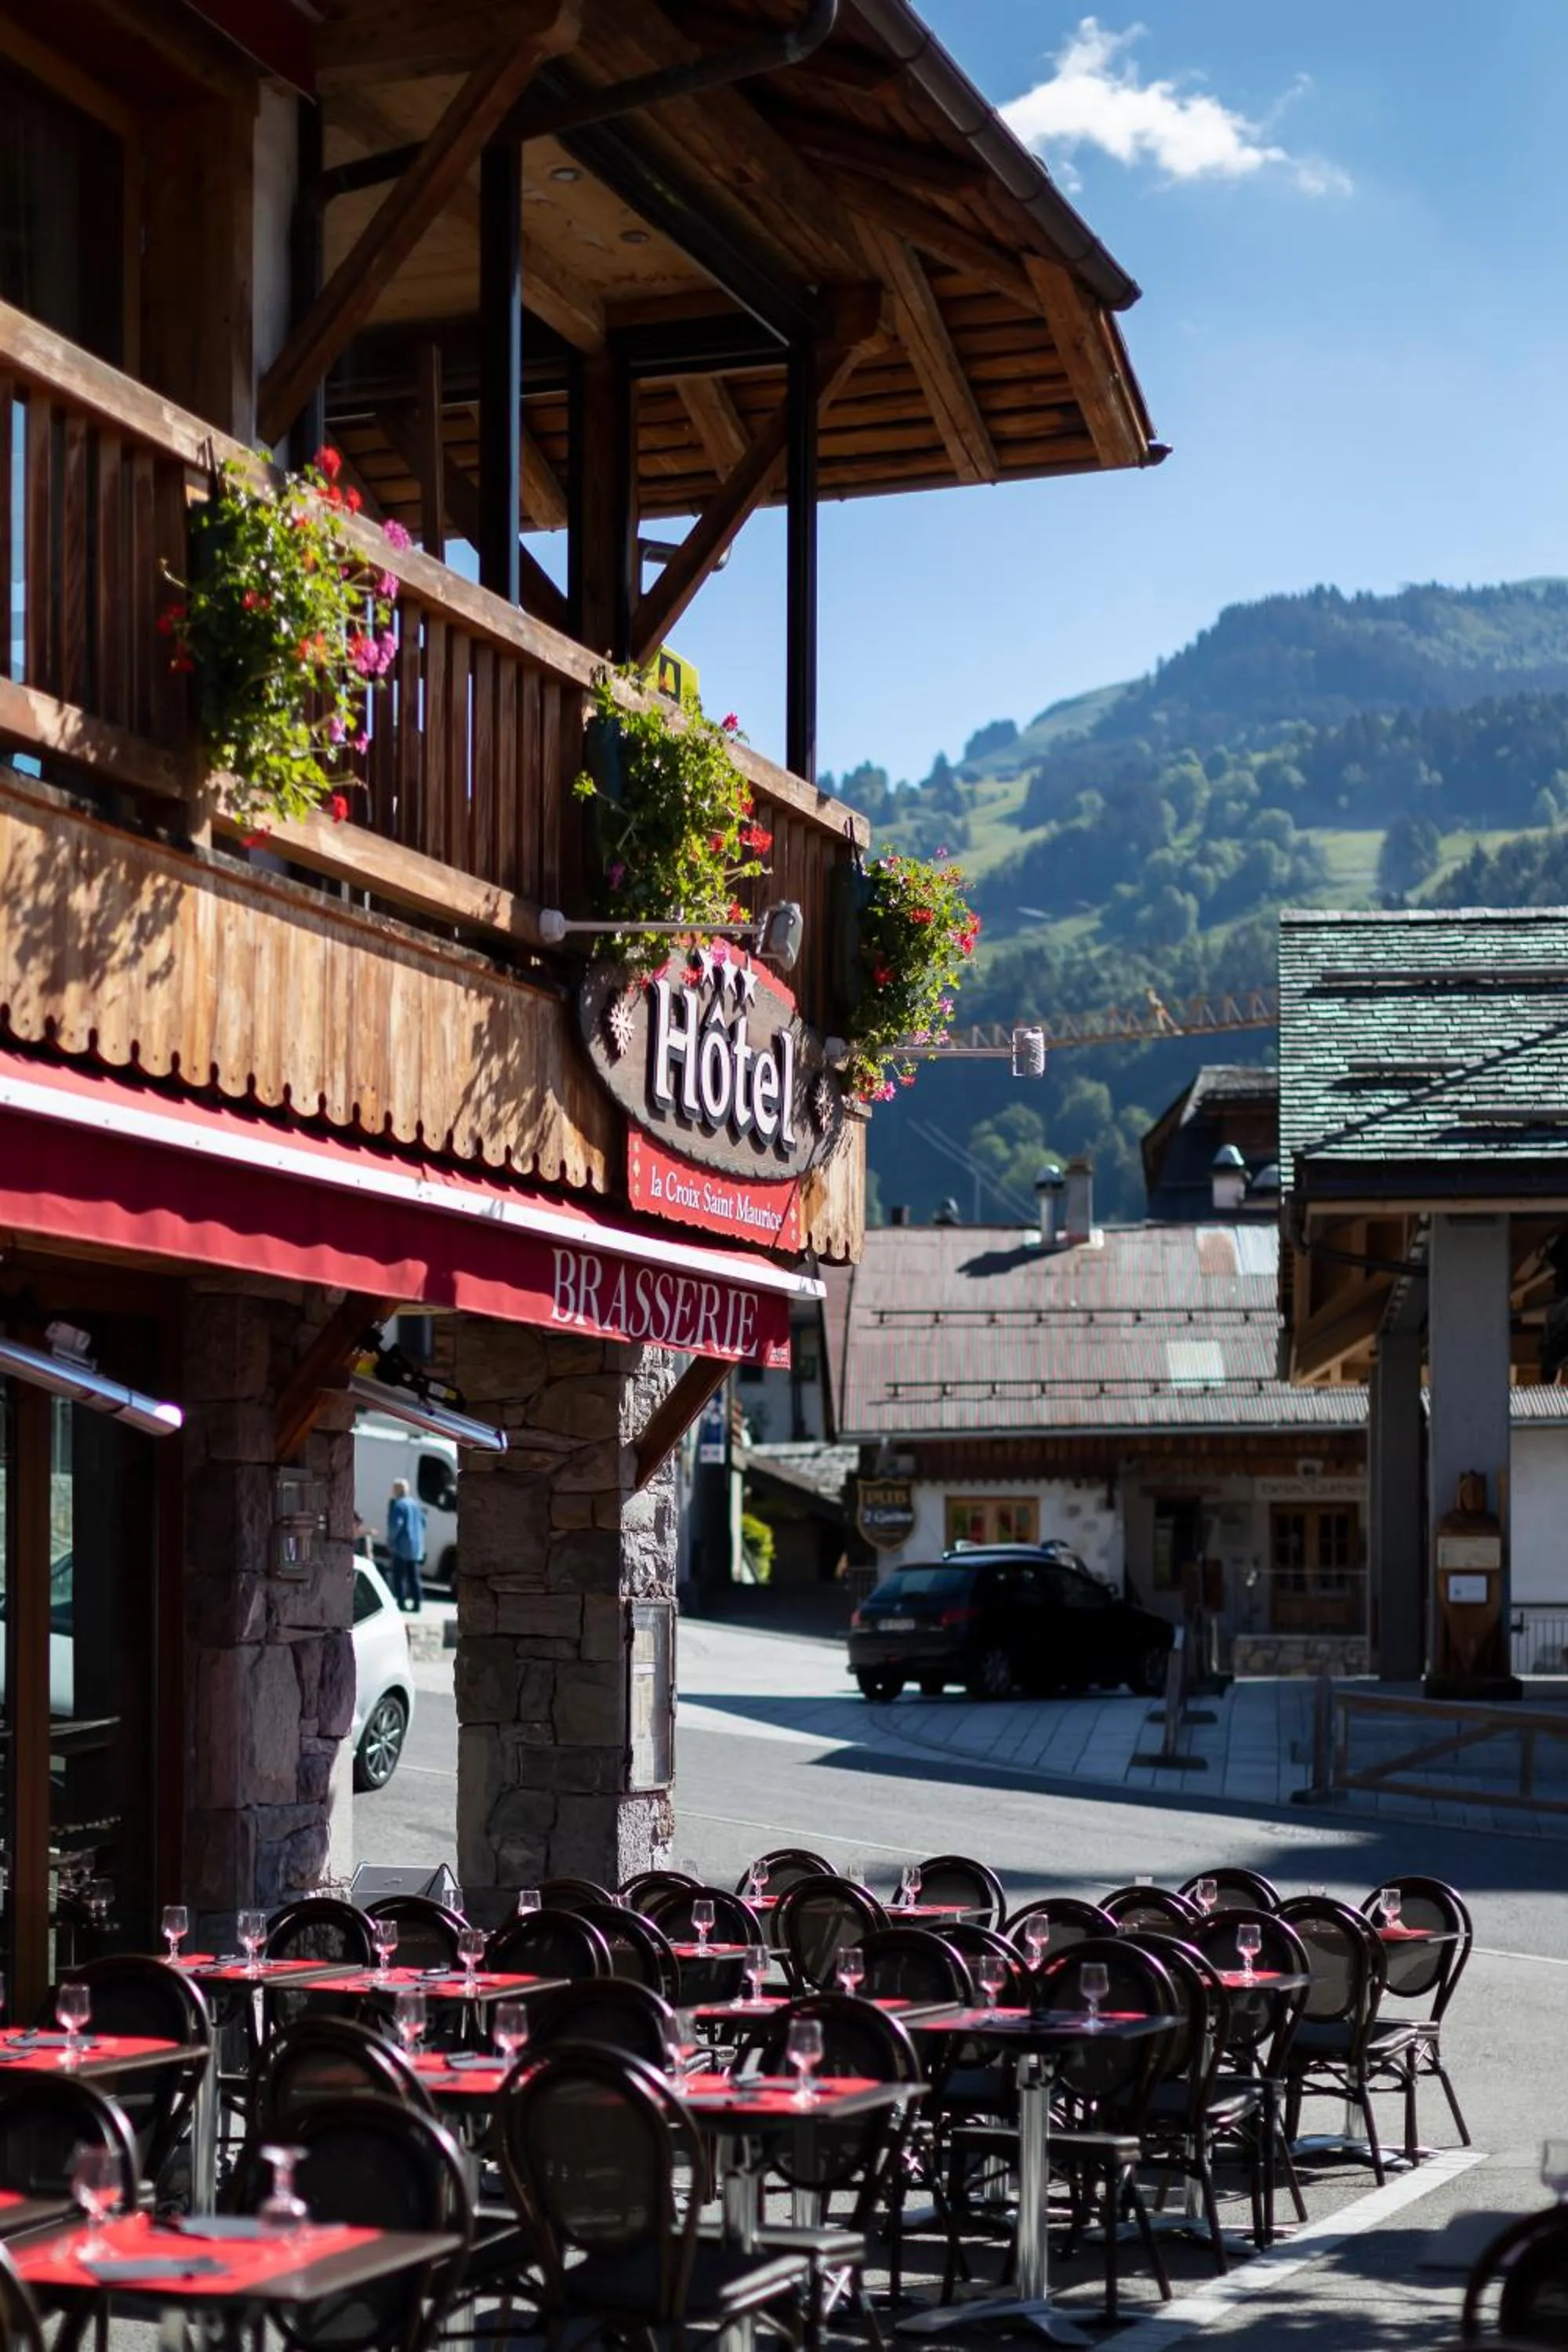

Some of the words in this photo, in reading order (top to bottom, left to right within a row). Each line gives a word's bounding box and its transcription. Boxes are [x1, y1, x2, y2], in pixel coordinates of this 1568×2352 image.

[655, 979, 797, 1149] Hôtel
[650, 1165, 662, 1197] la
[666, 1171, 700, 1208] Croix
[703, 1181, 734, 1219] Saint
[735, 1192, 782, 1231] Maurice
[551, 1248, 759, 1358] BRASSERIE
[865, 1490, 908, 1504] PUB
